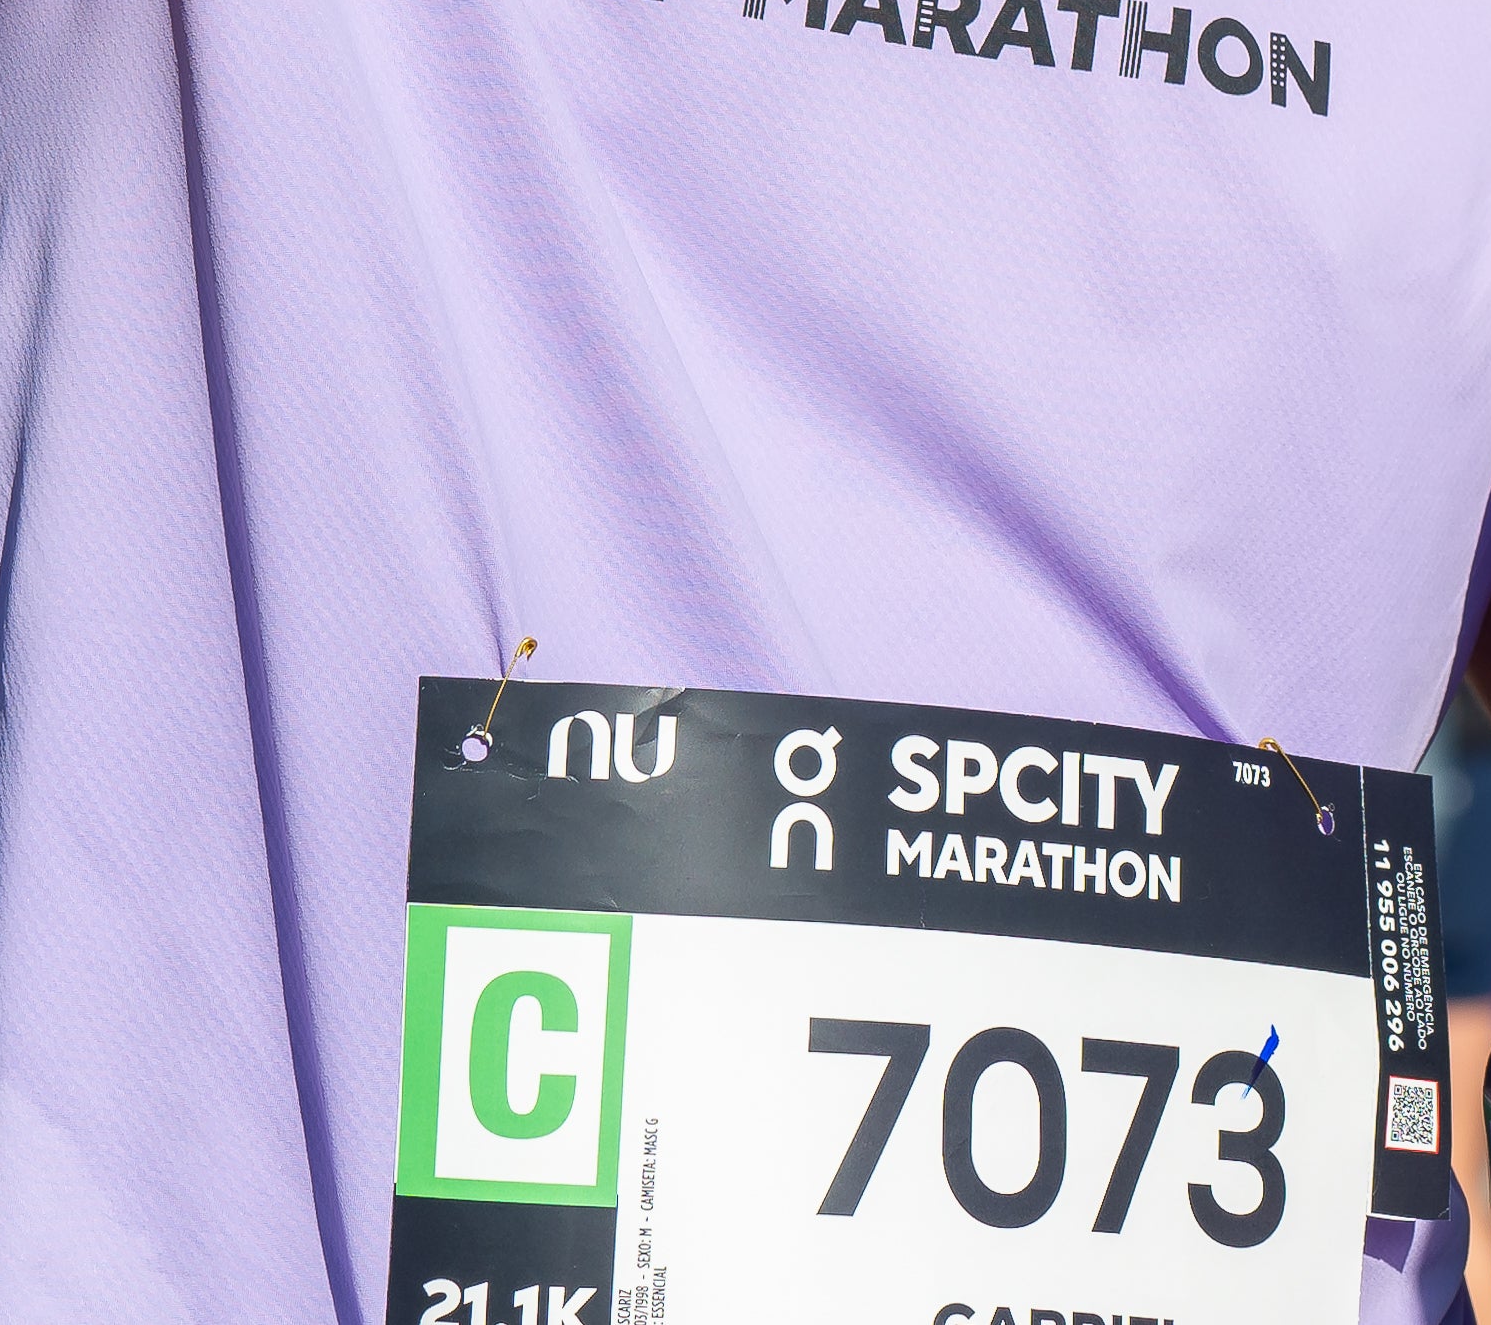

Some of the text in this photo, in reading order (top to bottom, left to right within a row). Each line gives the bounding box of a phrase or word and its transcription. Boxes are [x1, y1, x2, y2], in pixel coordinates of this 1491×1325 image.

[545, 709, 679, 784] nu
[885, 734, 1182, 837] SPCITY
[1231, 759, 1272, 788] 7073
[885, 827, 1183, 905] MARATHON
[1396, 872, 1406, 894] OU
[1403, 846, 1417, 911] ESCANEIE
[1397, 896, 1409, 935] LIGUE
[1373, 839, 1405, 1052] 11 955 006 296
[1400, 937, 1411, 960] NO
[1410, 927, 1422, 986] QRCODE
[1414, 862, 1434, 1036] EM CASO DE EMERGÊNCIA
[1414, 988, 1425, 1010] AO
[467, 969, 580, 1141] C
[1416, 1013, 1428, 1051] LADO
[644, 1127, 658, 1156] MASC
[807, 1015, 1288, 1250] 7073
[640, 1158, 656, 1212] CAMISETA:
[637, 1239, 651, 1269] SEXO:
[639, 1227, 652, 1238] M
[651, 1266, 667, 1319] ESSENCIAL
